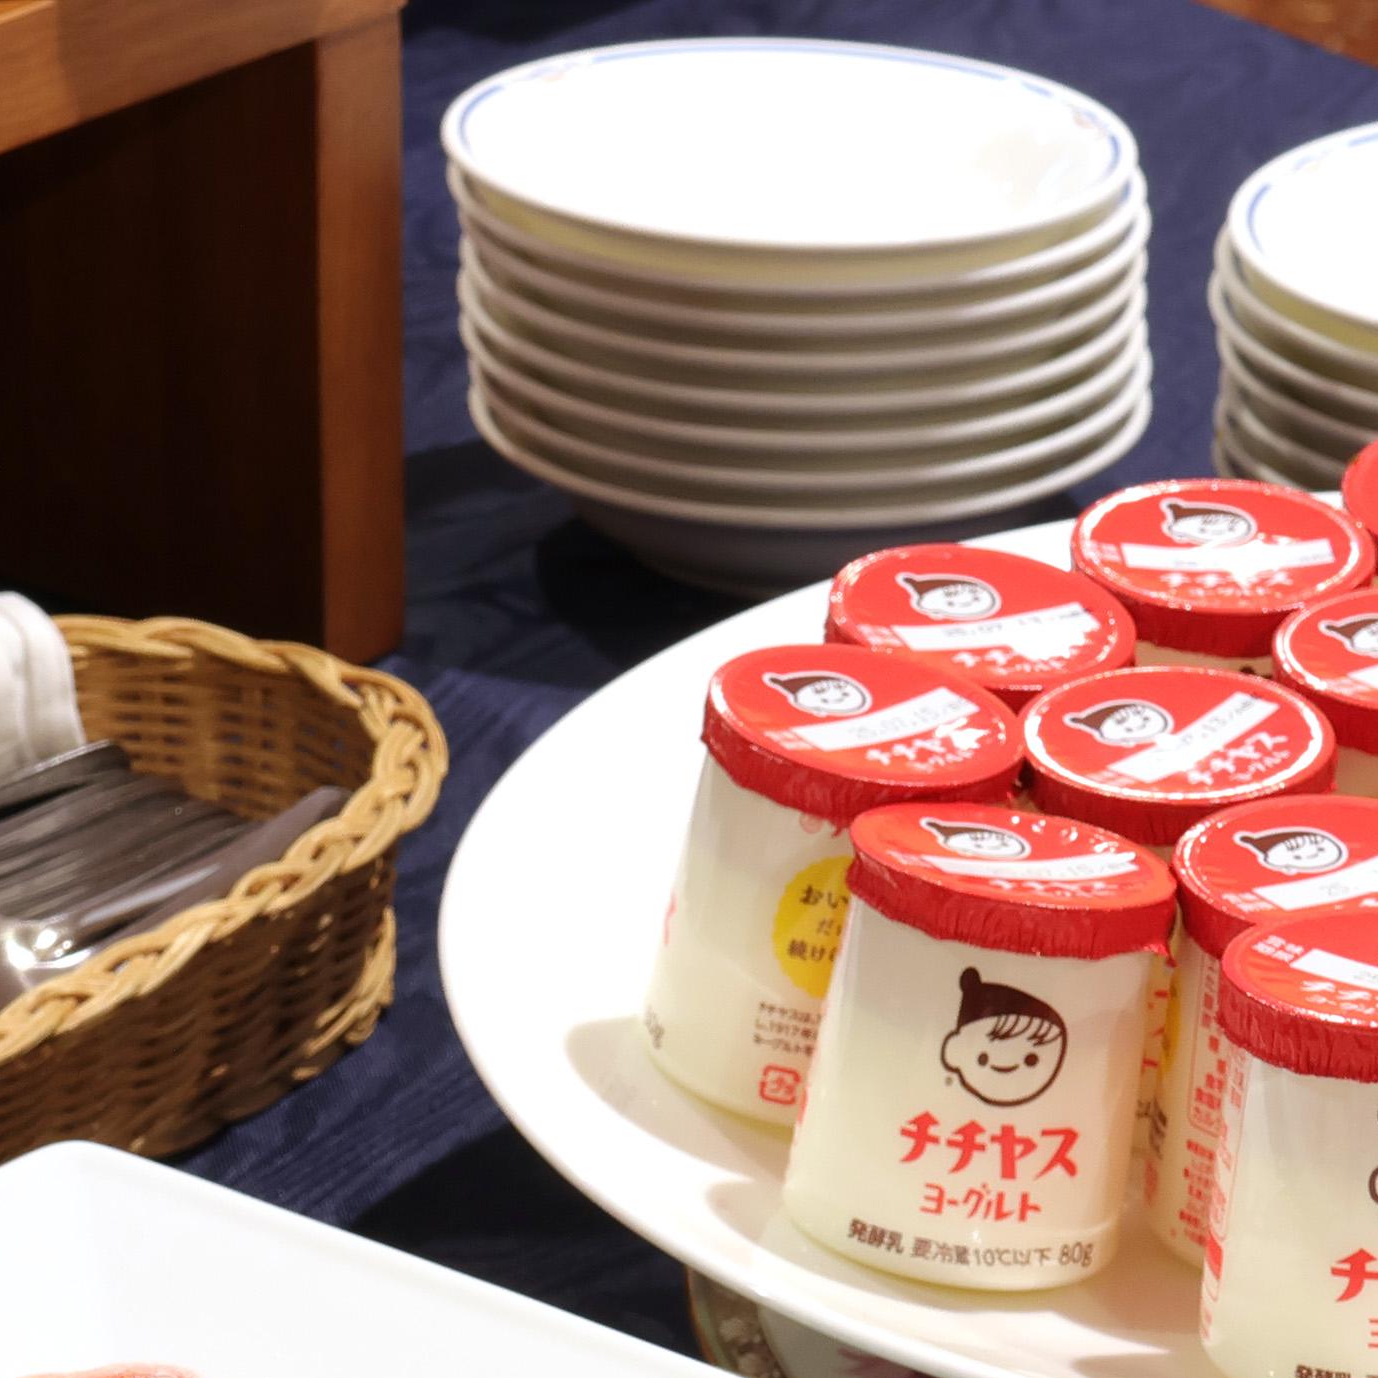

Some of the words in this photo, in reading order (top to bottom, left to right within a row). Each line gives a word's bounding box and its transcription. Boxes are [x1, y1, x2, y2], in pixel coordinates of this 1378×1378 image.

[898, 1111, 1080, 1180] チチヤス
[920, 1182, 1042, 1223] ヨーグルト
[847, 1218, 904, 1254] 発酵乳
[1058, 1241, 1095, 1268] 80g
